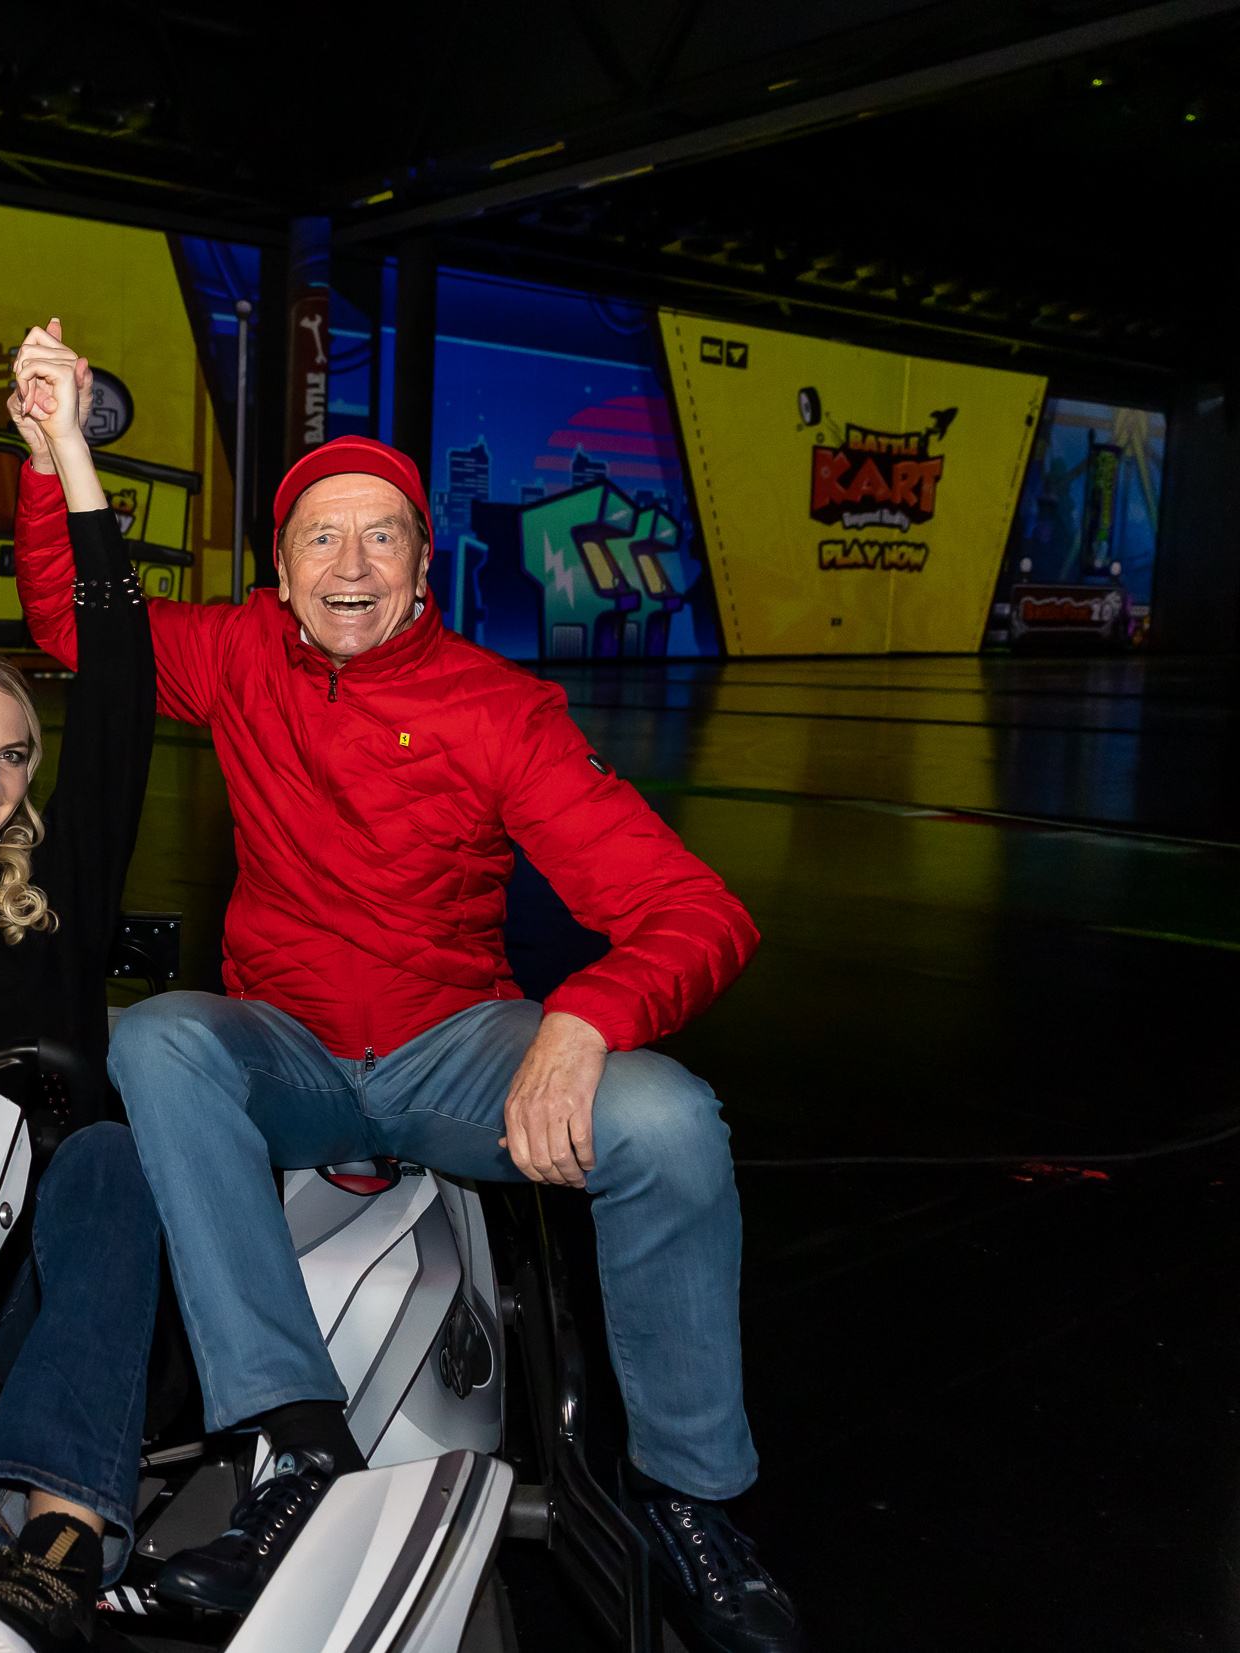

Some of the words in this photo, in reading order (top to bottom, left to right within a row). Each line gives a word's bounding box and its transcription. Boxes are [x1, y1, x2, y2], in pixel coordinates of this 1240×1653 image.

[847, 431, 920, 456] BATTLE
[812, 448, 943, 513] KART
[822, 543, 880, 567] PLAY
[883, 545, 926, 568] NOW
